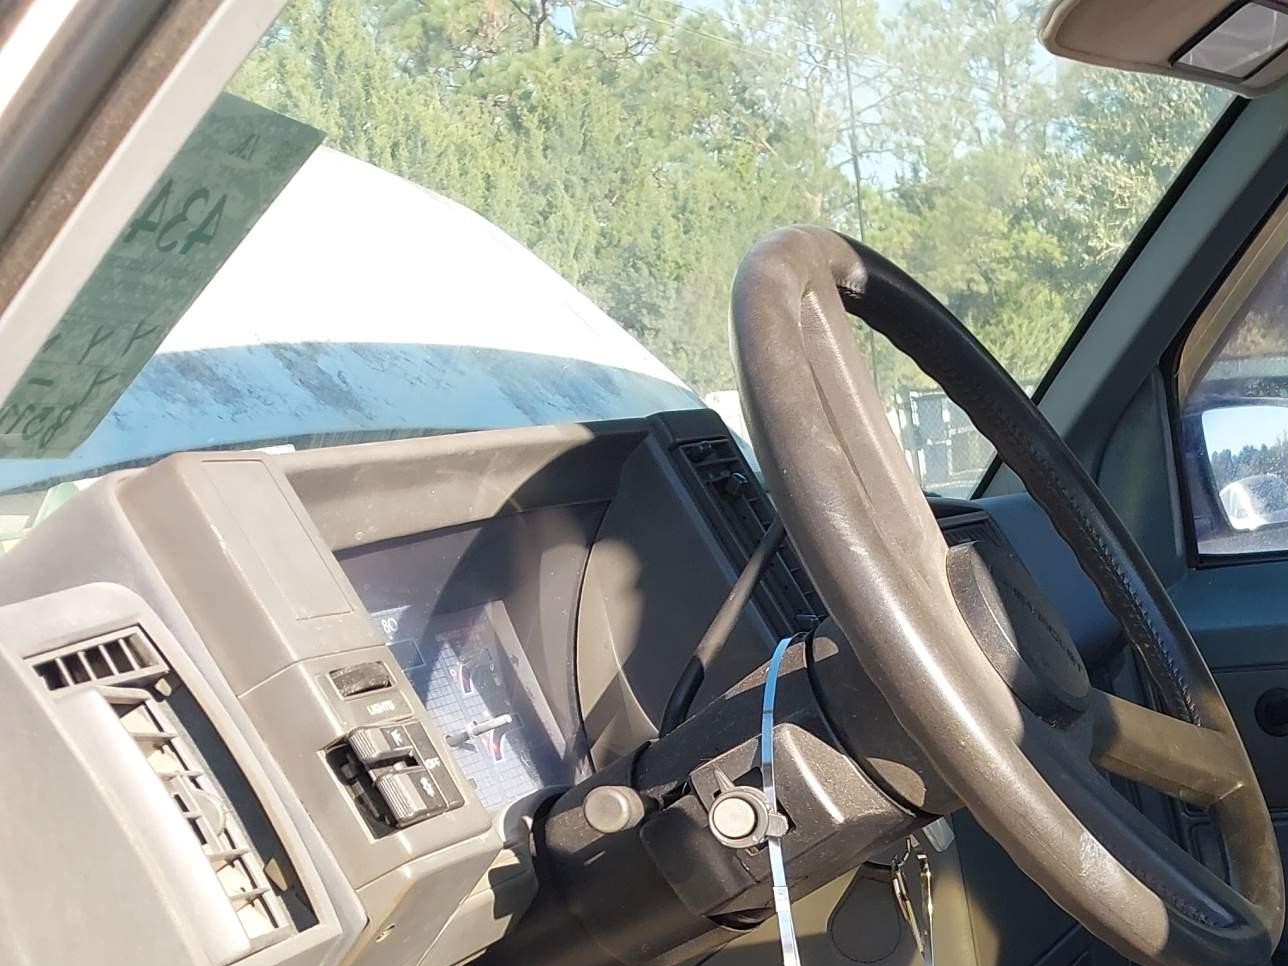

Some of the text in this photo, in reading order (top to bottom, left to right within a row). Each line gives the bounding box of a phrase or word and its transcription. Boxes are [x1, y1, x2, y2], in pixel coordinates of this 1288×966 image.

[381, 617, 398, 634] 80
[366, 700, 396, 717] LIGHTS
[424, 756, 441, 770] OFF
